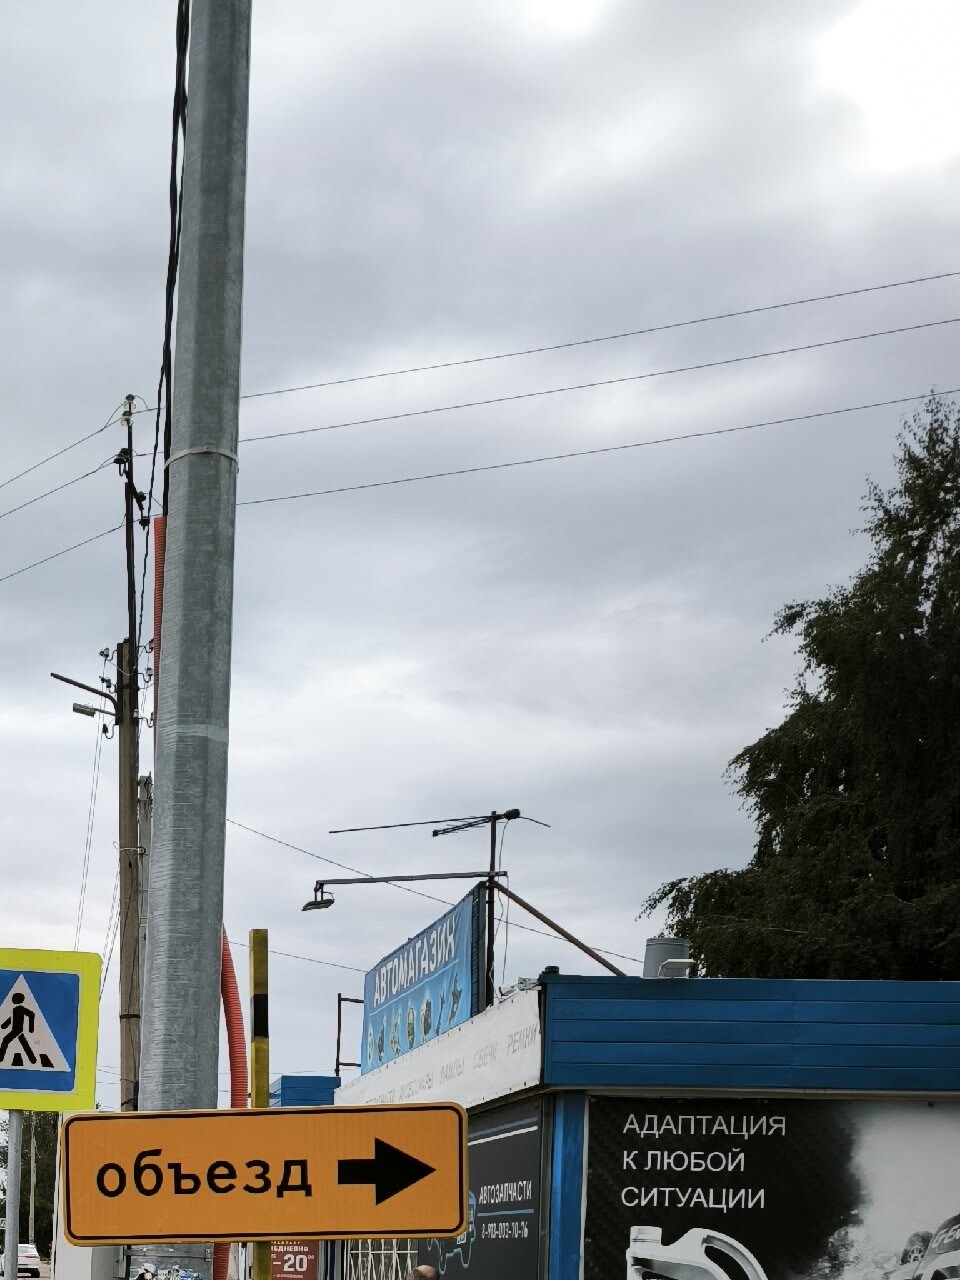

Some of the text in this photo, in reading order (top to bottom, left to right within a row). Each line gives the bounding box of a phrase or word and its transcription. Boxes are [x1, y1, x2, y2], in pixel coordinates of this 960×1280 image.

[373, 914, 456, 1008] АВТОМАГАЗИН
[507, 1023, 538, 1057] РЕМНИ
[622, 1113, 787, 1141] АДАПТАЦИЯ
[96, 1148, 313, 1199] объезд
[622, 1147, 745, 1172] К ЛЮБОЙ
[478, 1180, 533, 1205] АВТОЗАПЧАСТИ
[621, 1186, 766, 1214] СИТУАЦИИ
[283, 1253, 308, 1272] 20
